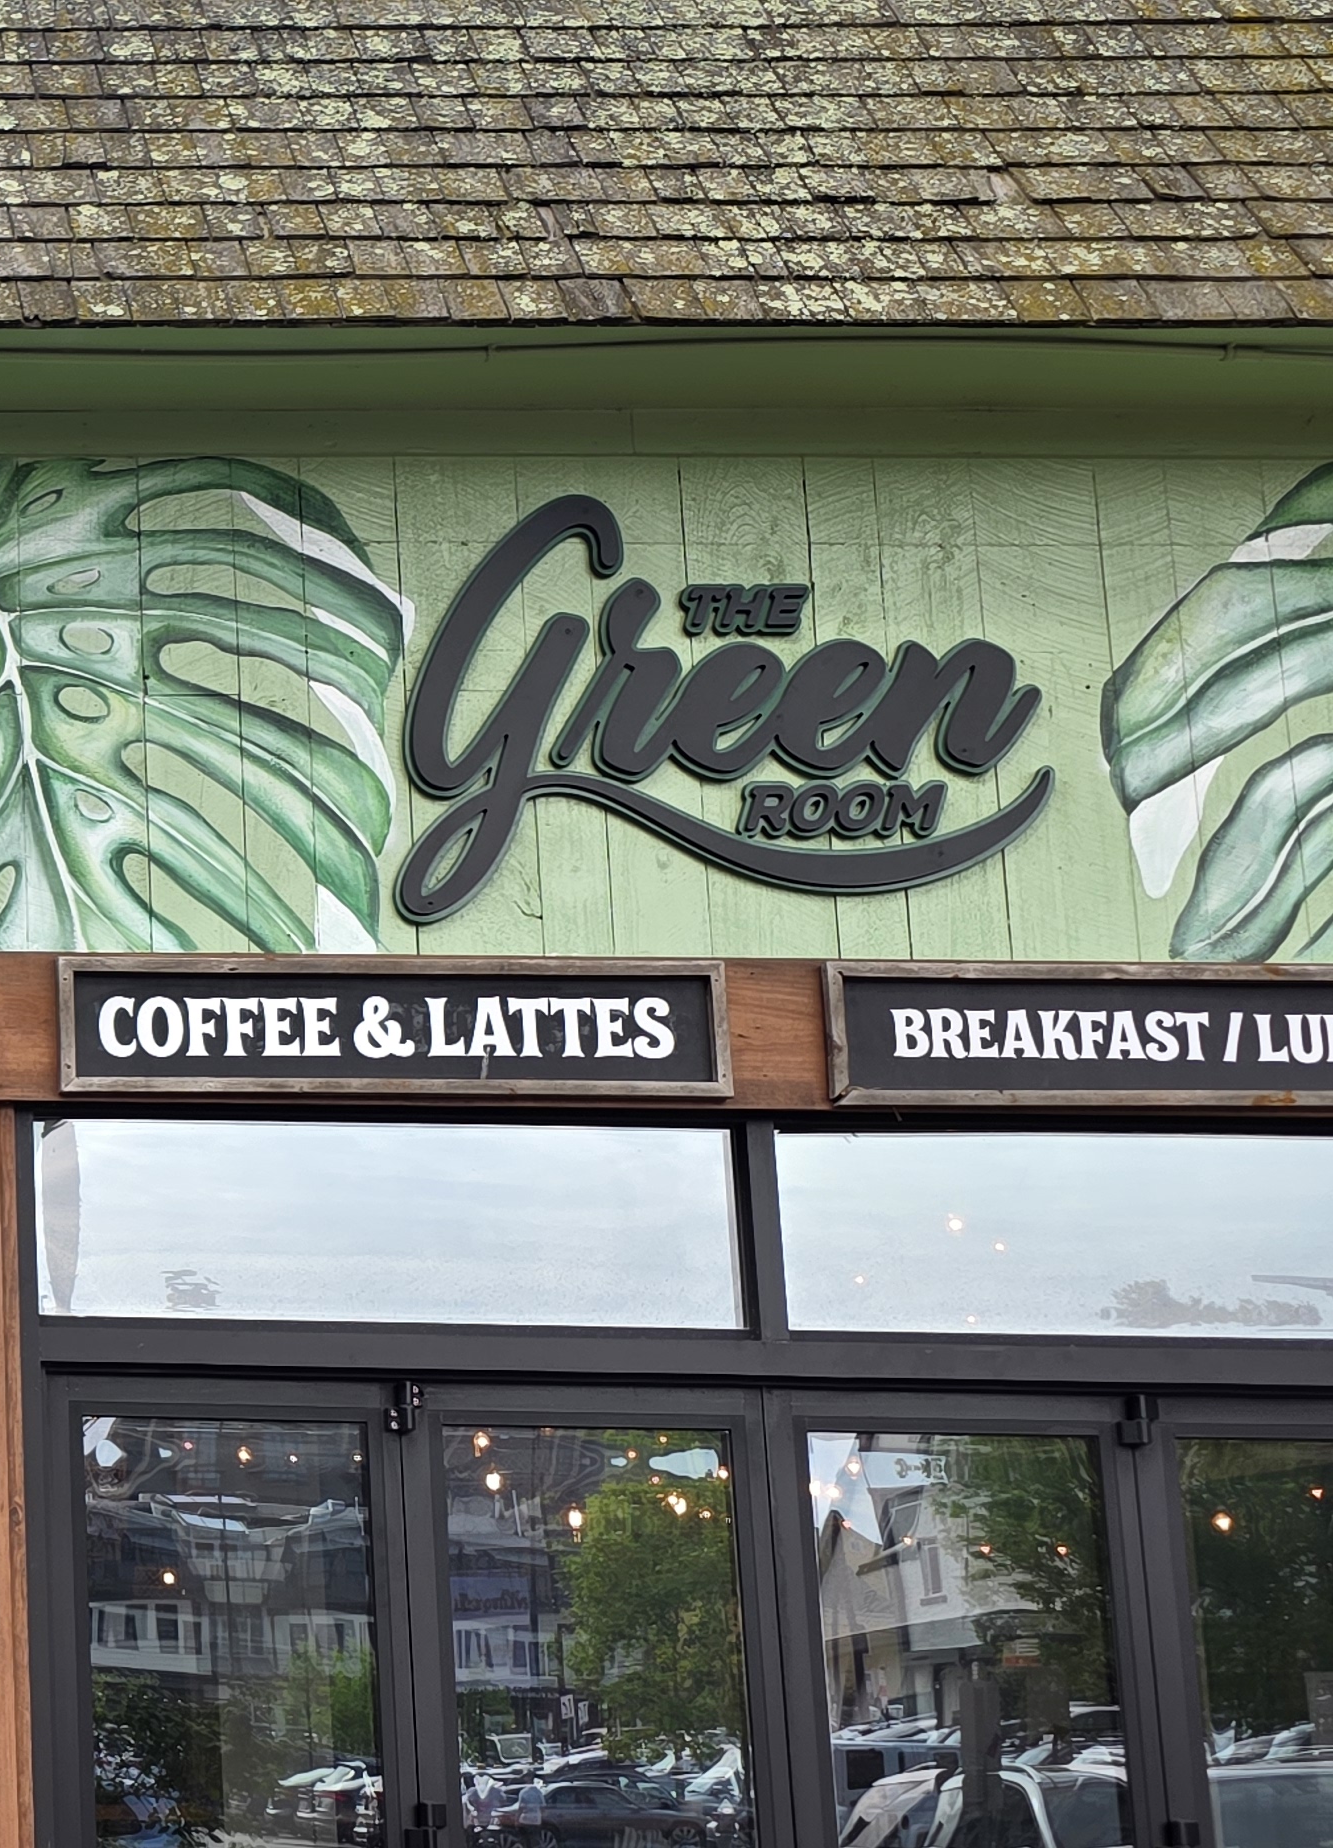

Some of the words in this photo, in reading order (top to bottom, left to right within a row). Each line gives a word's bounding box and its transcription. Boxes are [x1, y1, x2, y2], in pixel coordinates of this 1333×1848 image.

[680, 584, 809, 635] THE
[395, 494, 1048, 923] Green
[736, 780, 947, 838] ROOM
[98, 996, 342, 1058] COFFEE
[354, 995, 416, 1059] &
[425, 996, 675, 1059] LATTES
[889, 1008, 1210, 1062] BREAKFAST
[1223, 1012, 1244, 1063] /
[1253, 1013, 1333, 1064] LU
